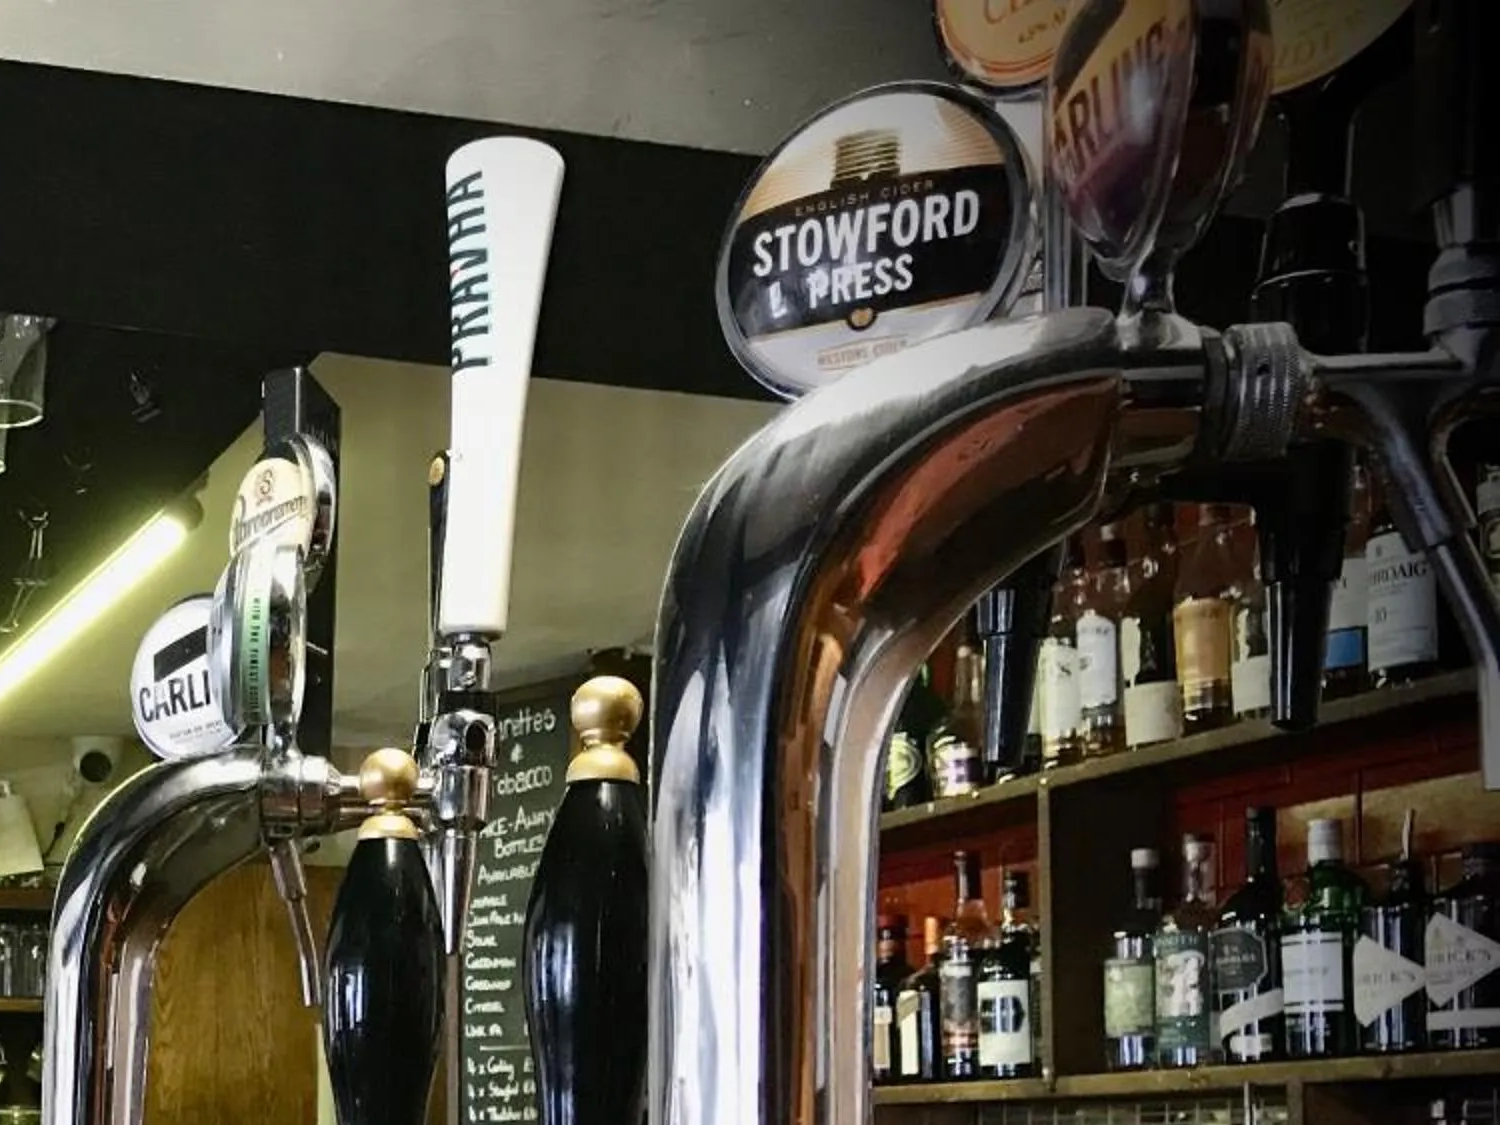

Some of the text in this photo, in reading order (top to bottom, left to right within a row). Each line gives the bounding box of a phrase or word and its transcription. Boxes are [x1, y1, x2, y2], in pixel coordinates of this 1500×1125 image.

[794, 179, 935, 217] ENGLISH CIDER
[752, 189, 980, 277] STOWFORD
[446, 170, 491, 374] PRAVHA
[806, 253, 914, 309] PRESS
[139, 669, 211, 723] CARLI
